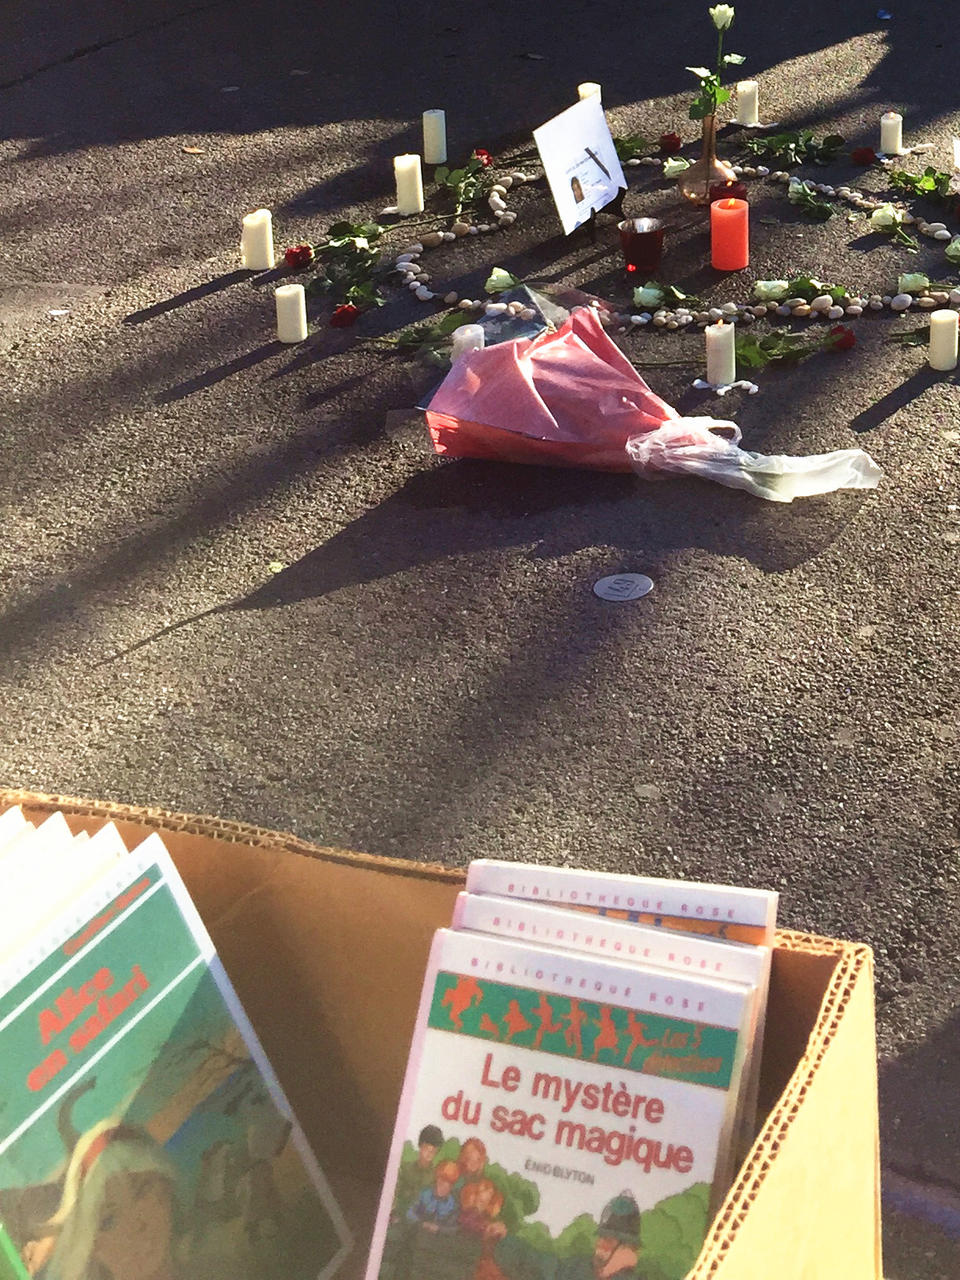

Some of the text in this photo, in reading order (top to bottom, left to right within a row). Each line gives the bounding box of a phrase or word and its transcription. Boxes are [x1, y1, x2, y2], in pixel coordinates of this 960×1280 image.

[507, 882, 736, 919] BIBLIOTHEQUE ROSE
[492, 916, 724, 973] BIBLIOTHEQUE ROSE
[470, 957, 706, 1012] BIBLIOTHEQUE ROSE
[480, 1052, 665, 1124] Le mystère
[441, 1089, 695, 1174] du sac magique
